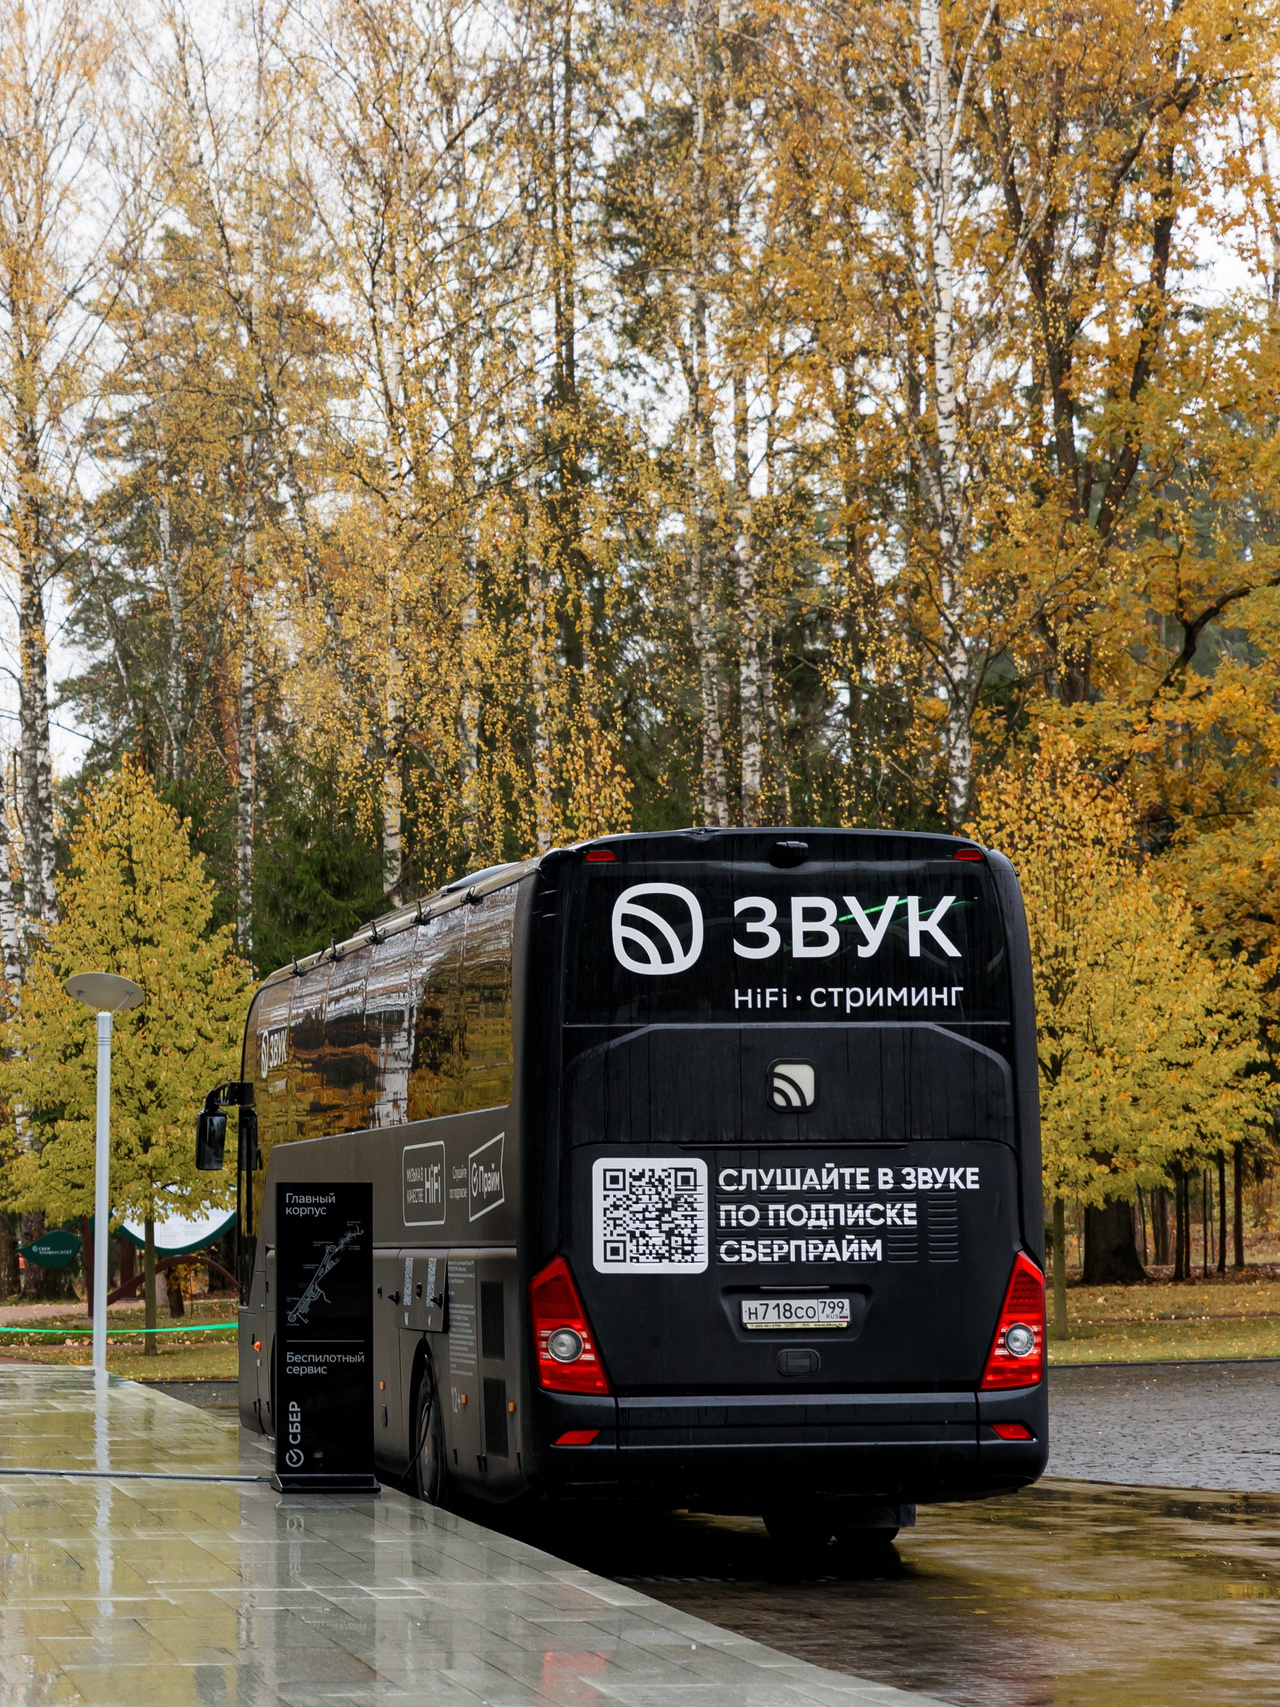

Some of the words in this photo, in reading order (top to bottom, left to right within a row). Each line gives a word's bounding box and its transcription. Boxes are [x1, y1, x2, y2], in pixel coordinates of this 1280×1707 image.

[733, 895, 963, 959] ЗВУК
[734, 988, 788, 1009] HiFi
[810, 986, 964, 1014] стриминг
[425, 1163, 441, 1204] HiFi
[479, 1162, 500, 1199] Прайм
[719, 1163, 870, 1191] СЛУШАЙТЕ
[878, 1167, 894, 1190] В
[900, 1167, 980, 1190] ЗВУКЕ
[285, 1192, 336, 1204] Главный
[285, 1206, 327, 1217] корпус
[720, 1204, 760, 1227] ПО
[768, 1203, 918, 1230] ПОДПИСКЕ
[720, 1235, 883, 1262] СБЕРПРАЙМ
[286, 1351, 365, 1363] Беспилотный
[286, 1366, 328, 1376] сервис
[288, 1401, 301, 1445] СБЕР
